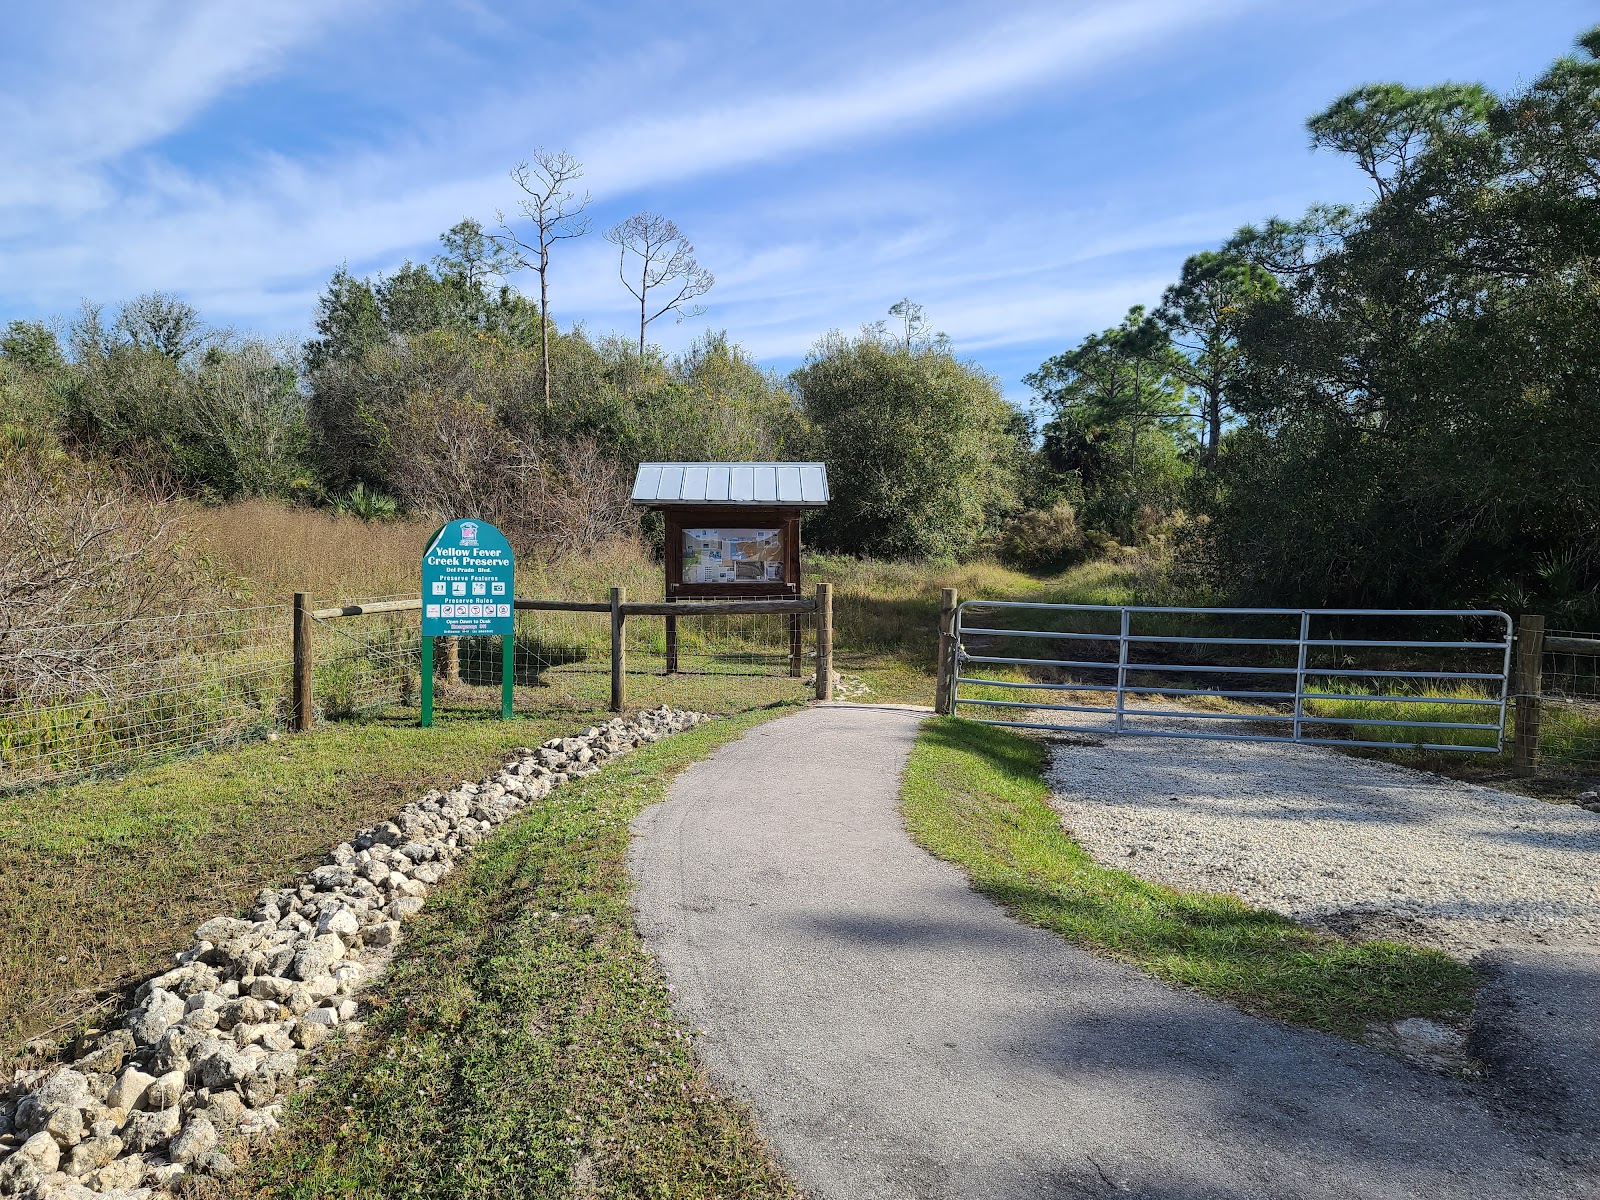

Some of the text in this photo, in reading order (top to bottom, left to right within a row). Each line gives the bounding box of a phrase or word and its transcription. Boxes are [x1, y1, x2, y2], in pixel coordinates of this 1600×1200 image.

[436, 548, 501, 556] Yellow Fever
[428, 557, 509, 566] Creek Preserve
